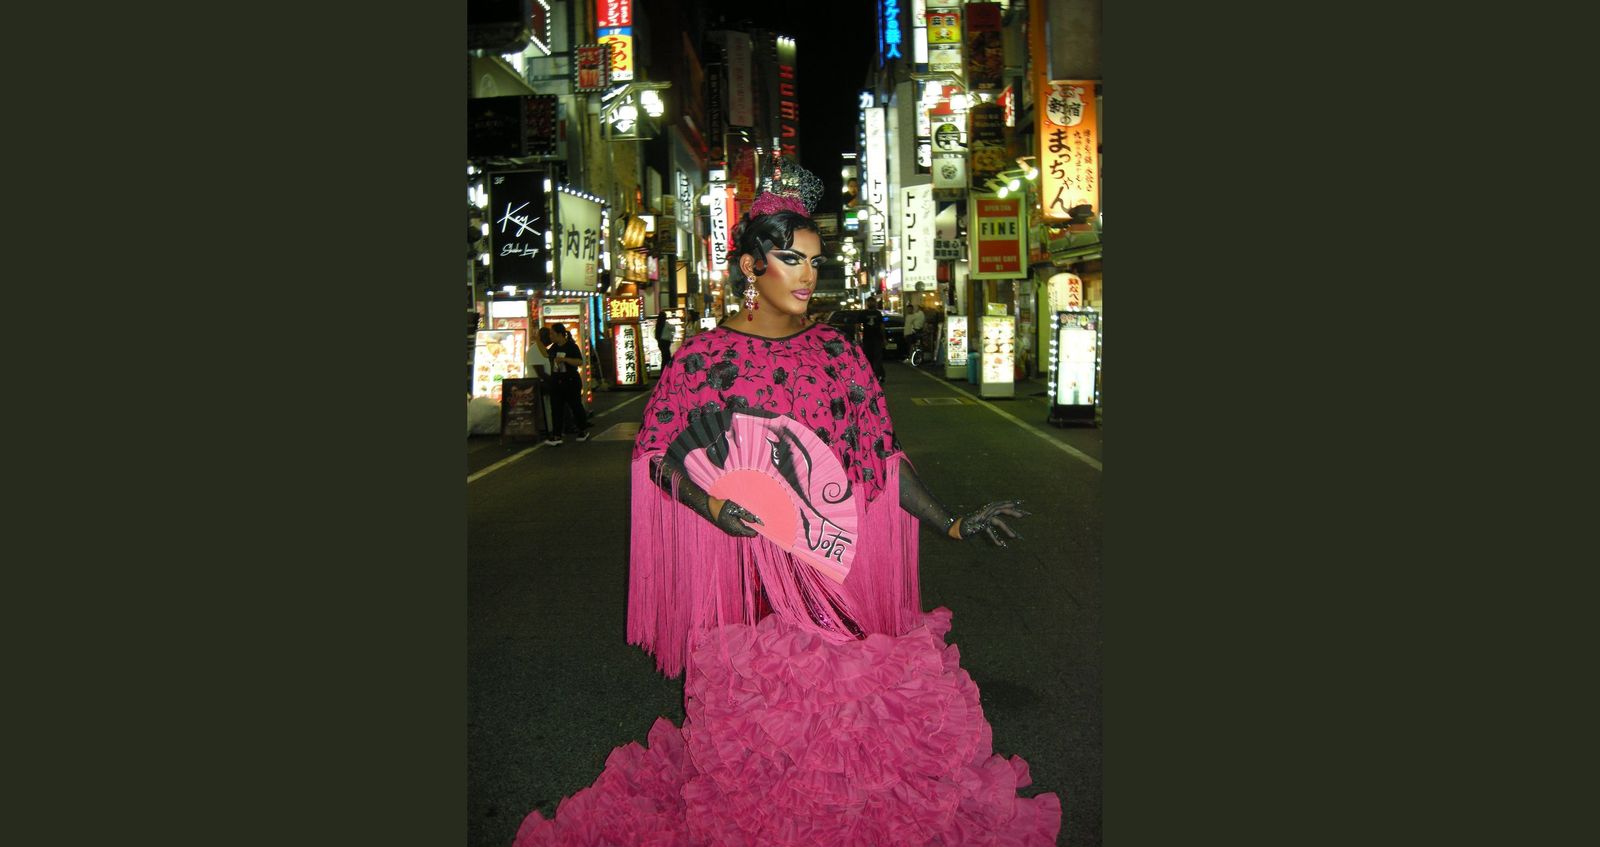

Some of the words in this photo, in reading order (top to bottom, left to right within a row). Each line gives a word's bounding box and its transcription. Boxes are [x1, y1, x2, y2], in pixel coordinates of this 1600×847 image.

[1048, 128, 1073, 213] まっちゃん
[497, 202, 541, 238] Key
[907, 191, 916, 272] トントン
[981, 222, 1016, 235] FINE
[610, 299, 639, 318] 案内所
[623, 328, 637, 383] 無料案内所
